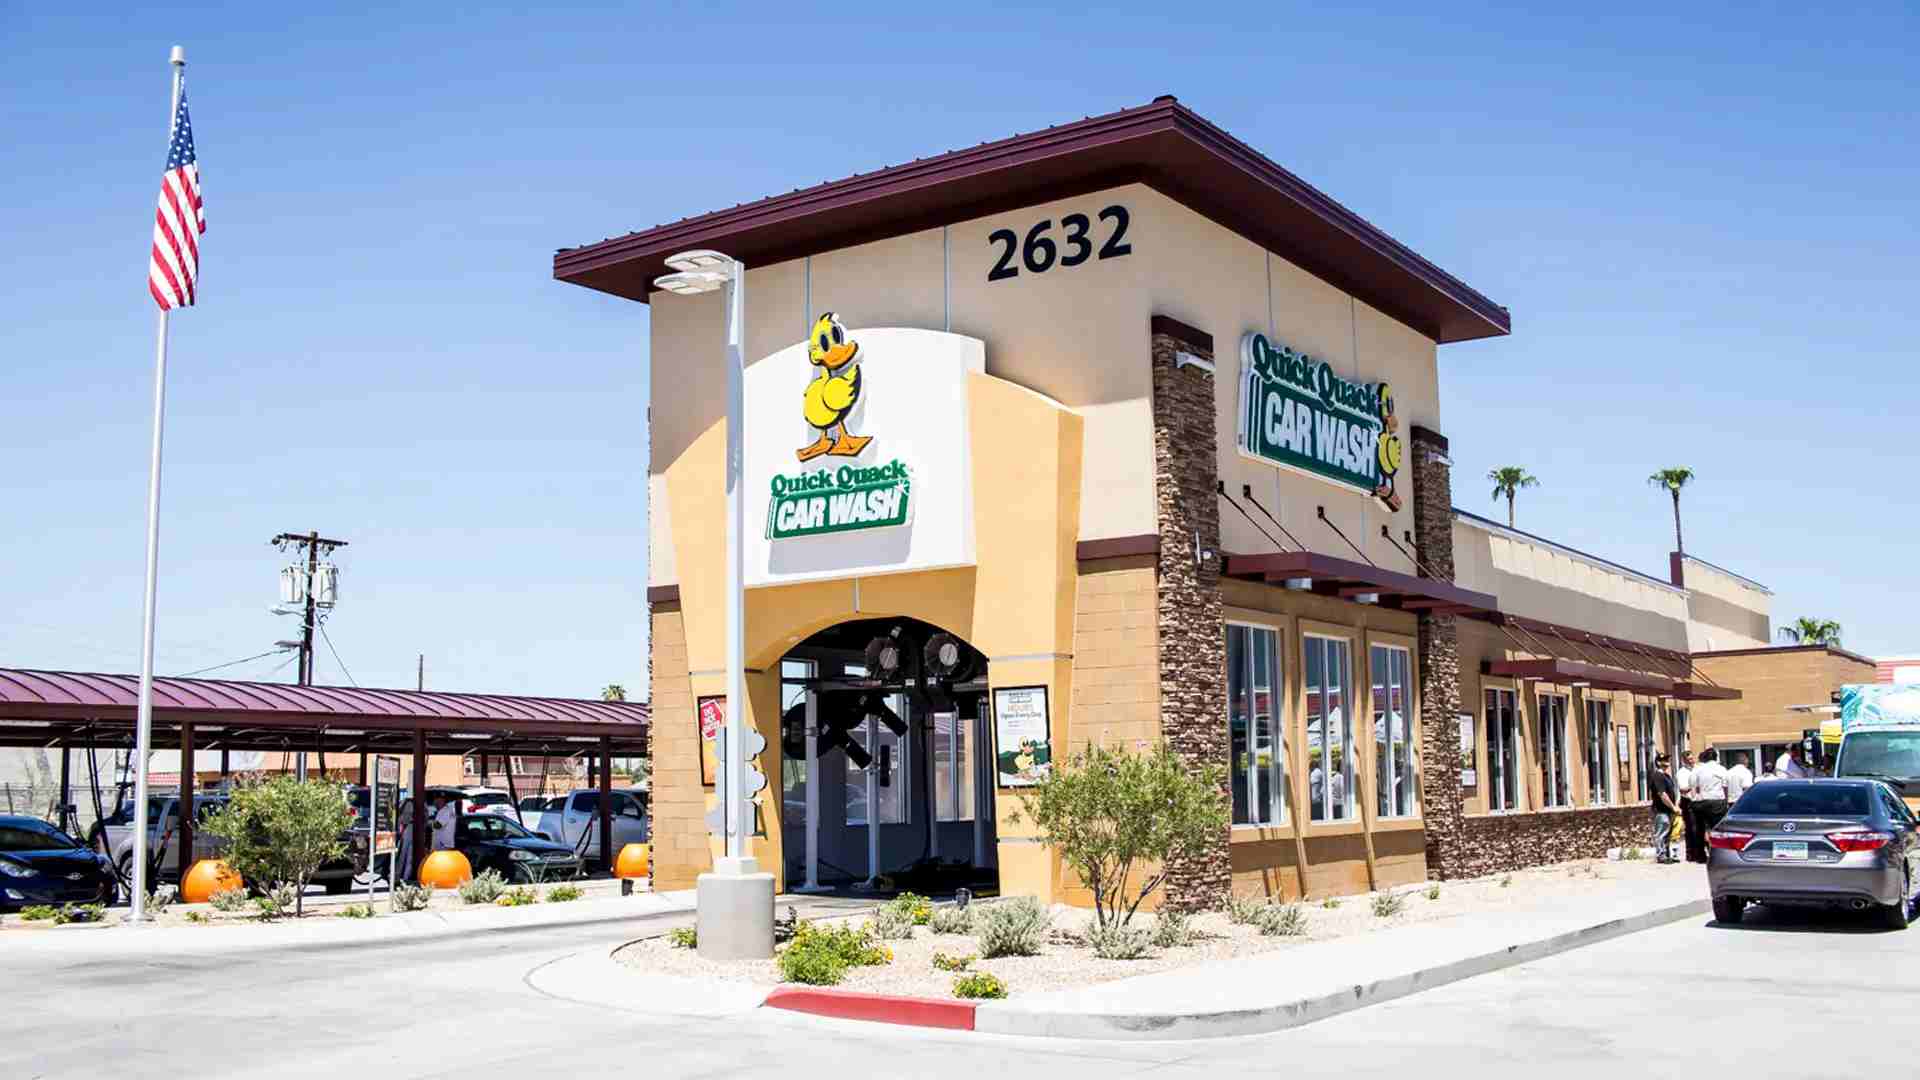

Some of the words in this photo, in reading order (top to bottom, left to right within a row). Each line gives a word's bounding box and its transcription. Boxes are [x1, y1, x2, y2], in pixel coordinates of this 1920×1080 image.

[988, 205, 1131, 282] 2632
[1253, 334, 1316, 391] Quick
[1317, 362, 1380, 417] Quack
[1265, 392, 1312, 457] CAR
[1314, 410, 1378, 479] WASH
[771, 469, 833, 497] Quick
[836, 459, 908, 490] Quack
[777, 496, 827, 531] CAR
[829, 487, 902, 525] WASH
